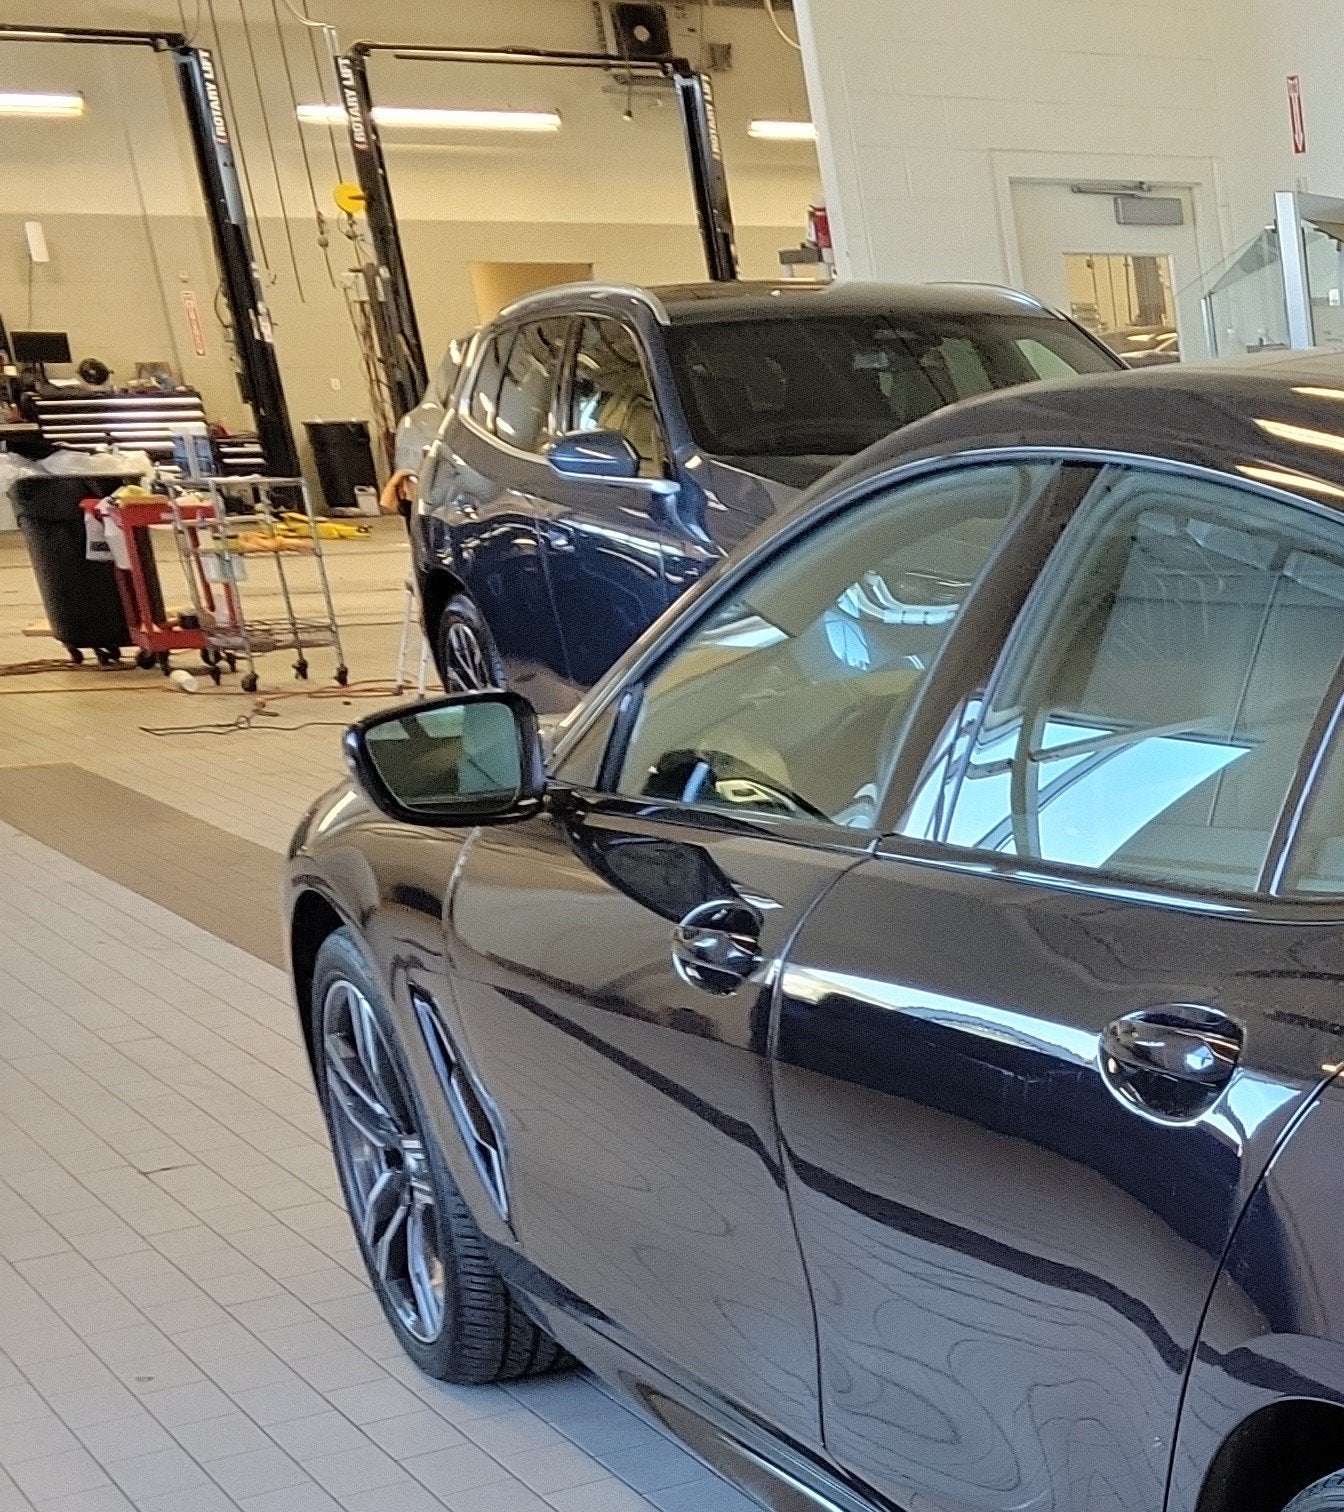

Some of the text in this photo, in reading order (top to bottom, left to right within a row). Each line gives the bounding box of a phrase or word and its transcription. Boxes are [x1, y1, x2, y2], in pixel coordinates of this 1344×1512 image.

[198, 49, 228, 137] ROTARY LIFT
[337, 57, 367, 142] ROTARY LIFT
